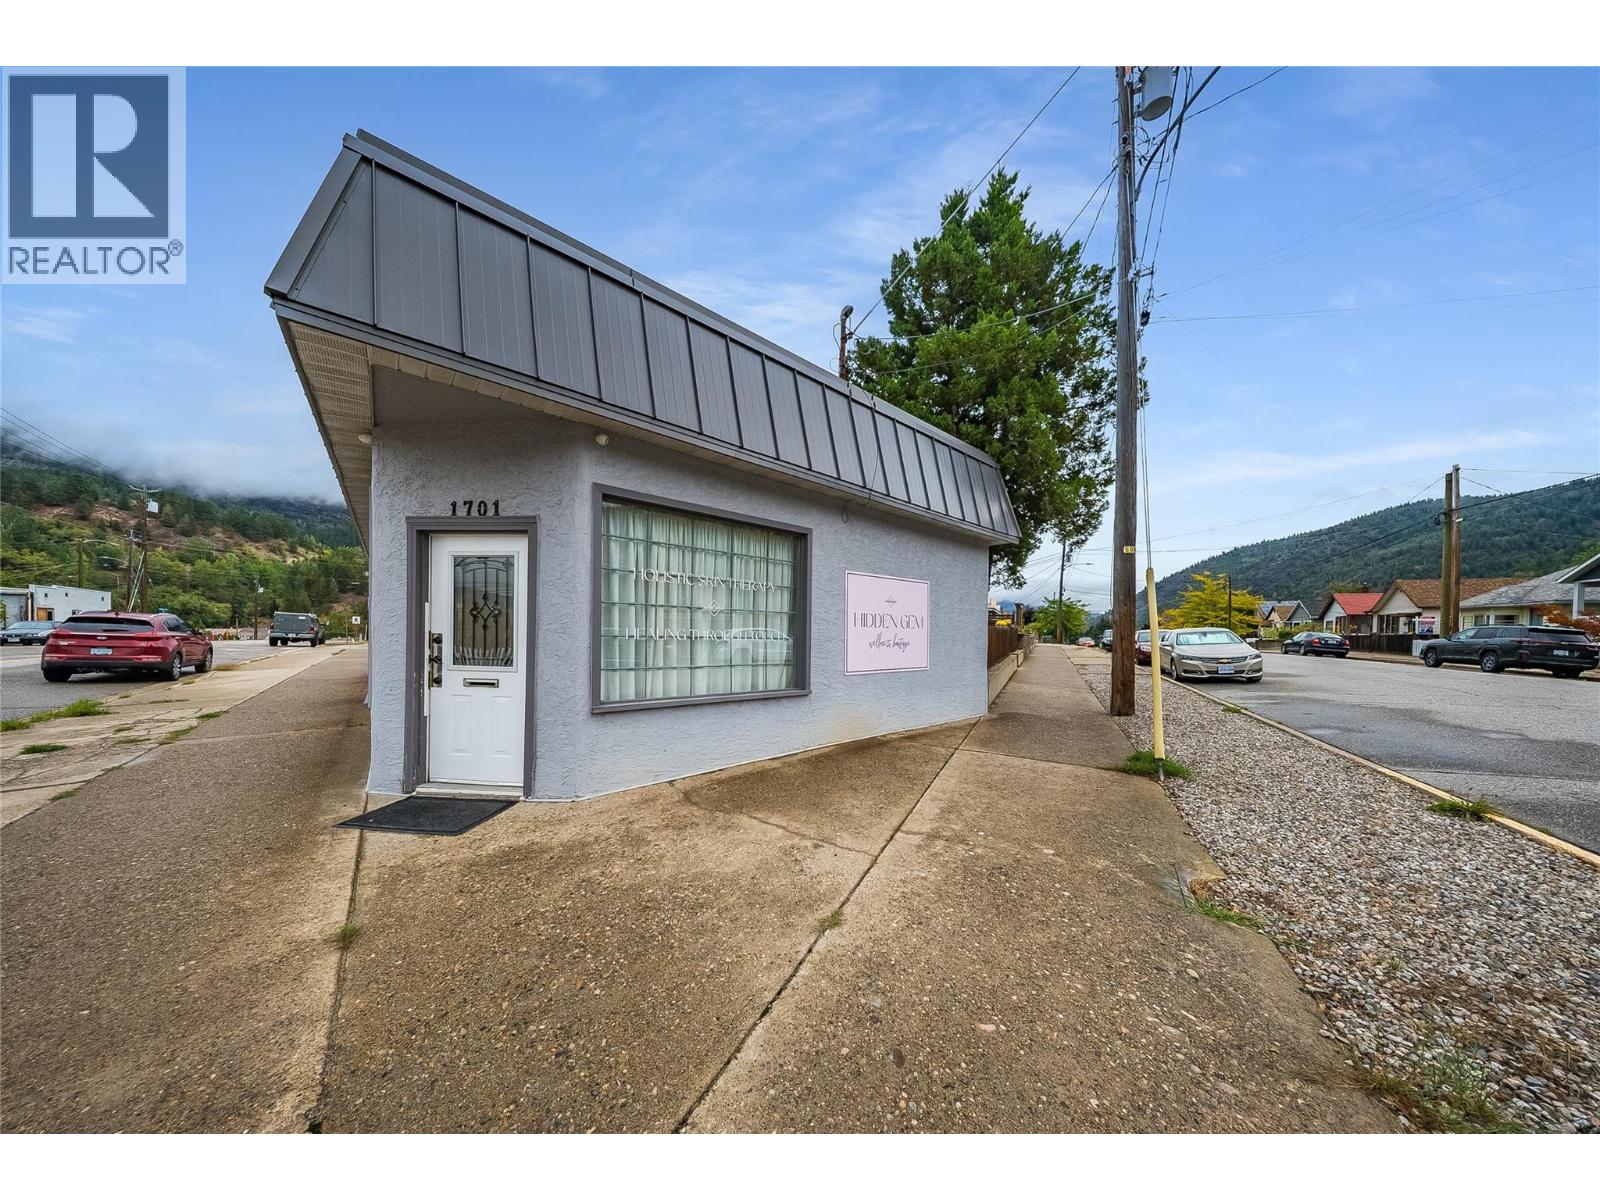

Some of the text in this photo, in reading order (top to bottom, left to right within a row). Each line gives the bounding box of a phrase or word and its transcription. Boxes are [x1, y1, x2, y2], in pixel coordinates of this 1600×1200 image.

[450, 499, 500, 517] 1701
[633, 567, 776, 593] HOLISTIC SKIN THERAPY
[853, 612, 924, 630] HIDDEN GEM
[625, 627, 687, 641] HEALING
[689, 628, 747, 642] THROUGH
